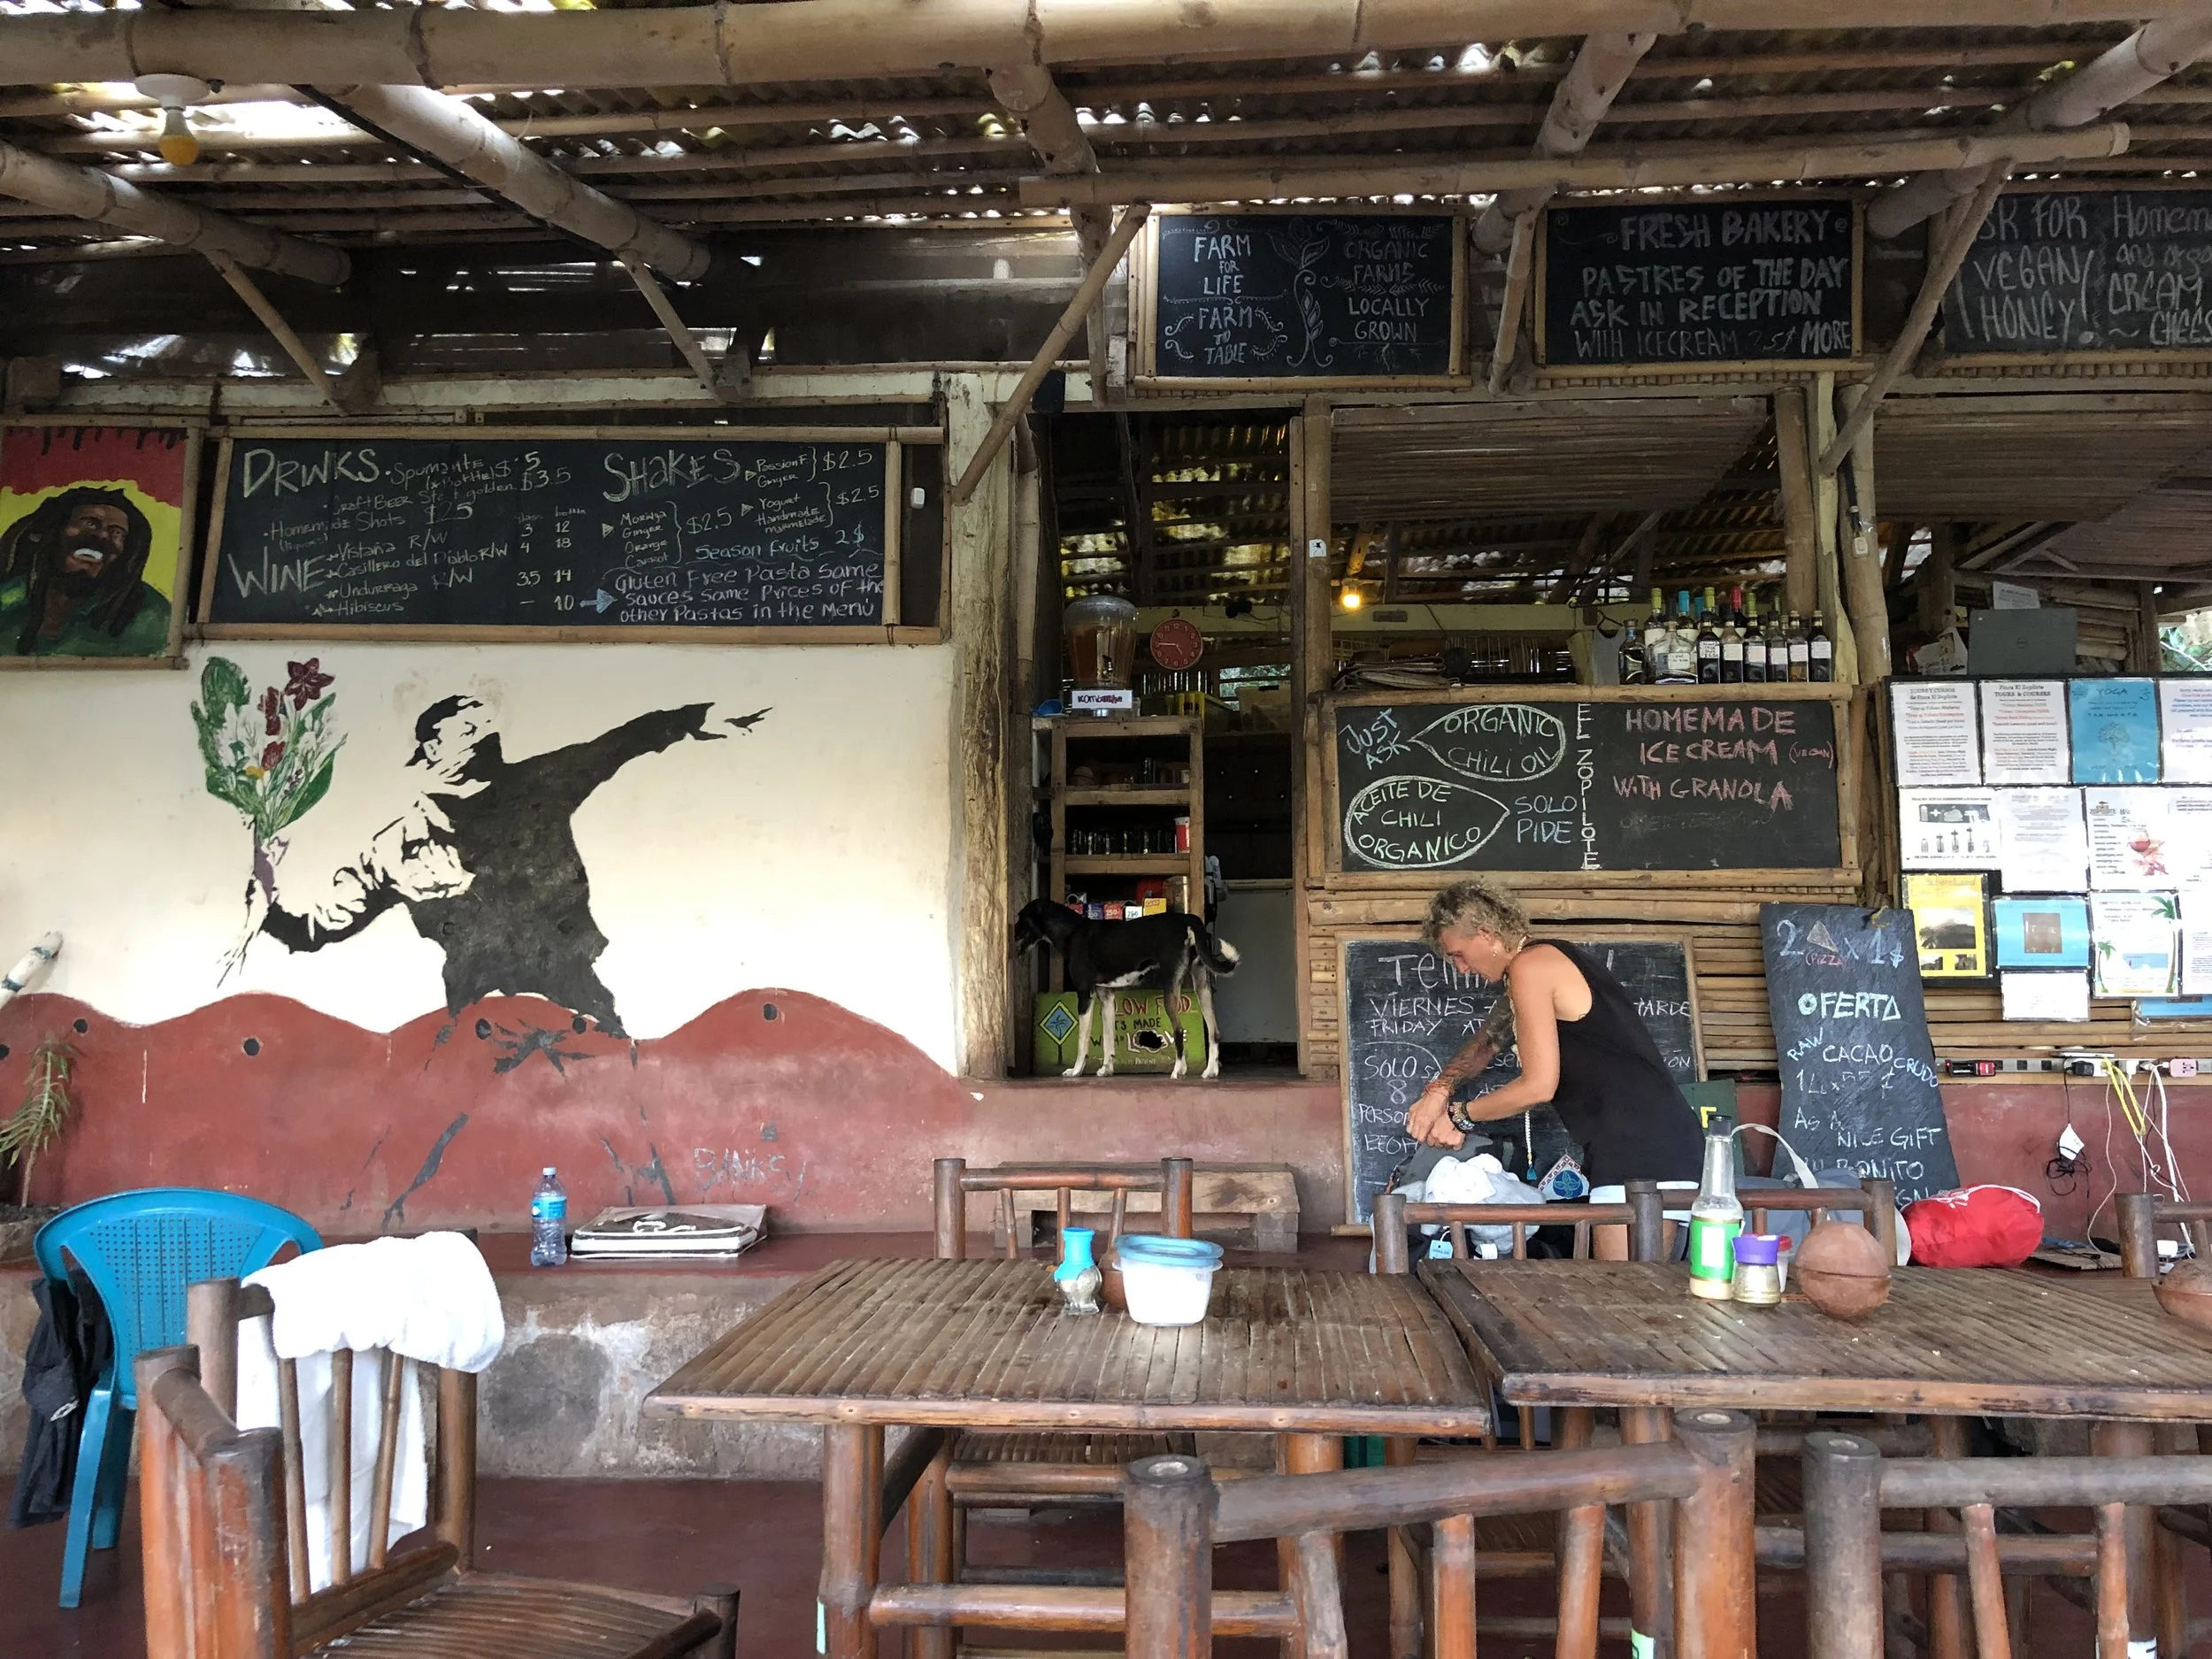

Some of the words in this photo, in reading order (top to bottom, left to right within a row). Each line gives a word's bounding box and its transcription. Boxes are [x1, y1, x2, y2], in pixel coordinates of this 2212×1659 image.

[1619, 212, 1711, 250] FRESH
[1721, 210, 1831, 245] BAKERY
[1979, 197, 2019, 241] SK
[2032, 196, 2086, 239] FOR
[2113, 194, 2212, 239] Homem
[1194, 234, 1251, 262] FARM
[1343, 239, 1429, 261] ORGANIC
[1219, 259, 1240, 274] FOR
[1353, 262, 1416, 285] FARMS
[1717, 265, 1747, 290] OF
[1752, 257, 1794, 287] THE
[1800, 256, 1849, 288] DAY
[1973, 244, 2081, 290] VEGAN
[1203, 274, 1244, 296] LIFE
[2108, 271, 2202, 315] CREAM
[1198, 305, 1253, 330] FARM
[1348, 296, 1430, 318] LOCALLY
[1570, 298, 1630, 328] ASK
[1640, 301, 1663, 326] IN
[1678, 288, 1823, 324] RECEPTION
[1213, 330, 1231, 346] TO
[1354, 320, 1417, 343] GROWN
[1574, 328, 1624, 358] WITH
[1801, 319, 1852, 355] MORE
[1204, 342, 1248, 365] TABLE
[822, 449, 872, 472] $2.5
[835, 485, 879, 506] $2.5
[356, 511, 406, 532] Shots
[520, 522, 534, 537] 3
[554, 519, 571, 534] 12
[686, 505, 733, 535] $2.5
[519, 542, 530, 554] 4
[554, 537, 572, 549] 18
[227, 545, 326, 599] WINE
[552, 568, 572, 584] 14
[614, 570, 678, 593] Gluten
[687, 568, 738, 590] Free
[747, 562, 810, 584] Pasta
[553, 594, 574, 611] 10
[753, 603, 772, 619] in
[778, 601, 815, 620] the
[2096, 687, 2129, 696] YOGA
[1338, 708, 1399, 755] JUST
[1443, 707, 1555, 737] ORGANIC
[1625, 706, 1796, 734] HOMEMADE
[1365, 730, 1411, 770] ASK
[1640, 740, 1680, 765] ICE
[1685, 738, 1778, 766] CREAM
[1352, 780, 1412, 825] ACEITE
[1417, 781, 1452, 803] DE
[1514, 795, 1578, 815] SOLO
[1670, 777, 1794, 812] GRANOLA
[1380, 810, 1441, 828] CHILI
[1517, 818, 1574, 844] PIDE
[1358, 826, 1481, 863] ORGANICO
[1777, 918, 1805, 957] 2
[1113, 996, 1148, 1018] LOW
[1797, 990, 1901, 1022] OFERTA
[1133, 1017, 1162, 1029] MADE
[1365, 1018, 1443, 1037] FRIDAY
[1462, 1018, 1486, 1036] AT
[1363, 1055, 1417, 1080] SOLO
[1786, 1026, 1824, 1062] RAW
[1822, 1043, 1893, 1066] CACAO
[1893, 1056, 1939, 1088] CRUDO
[1386, 1079, 1408, 1105] 8
[1837, 1127, 1885, 1148] NICE
